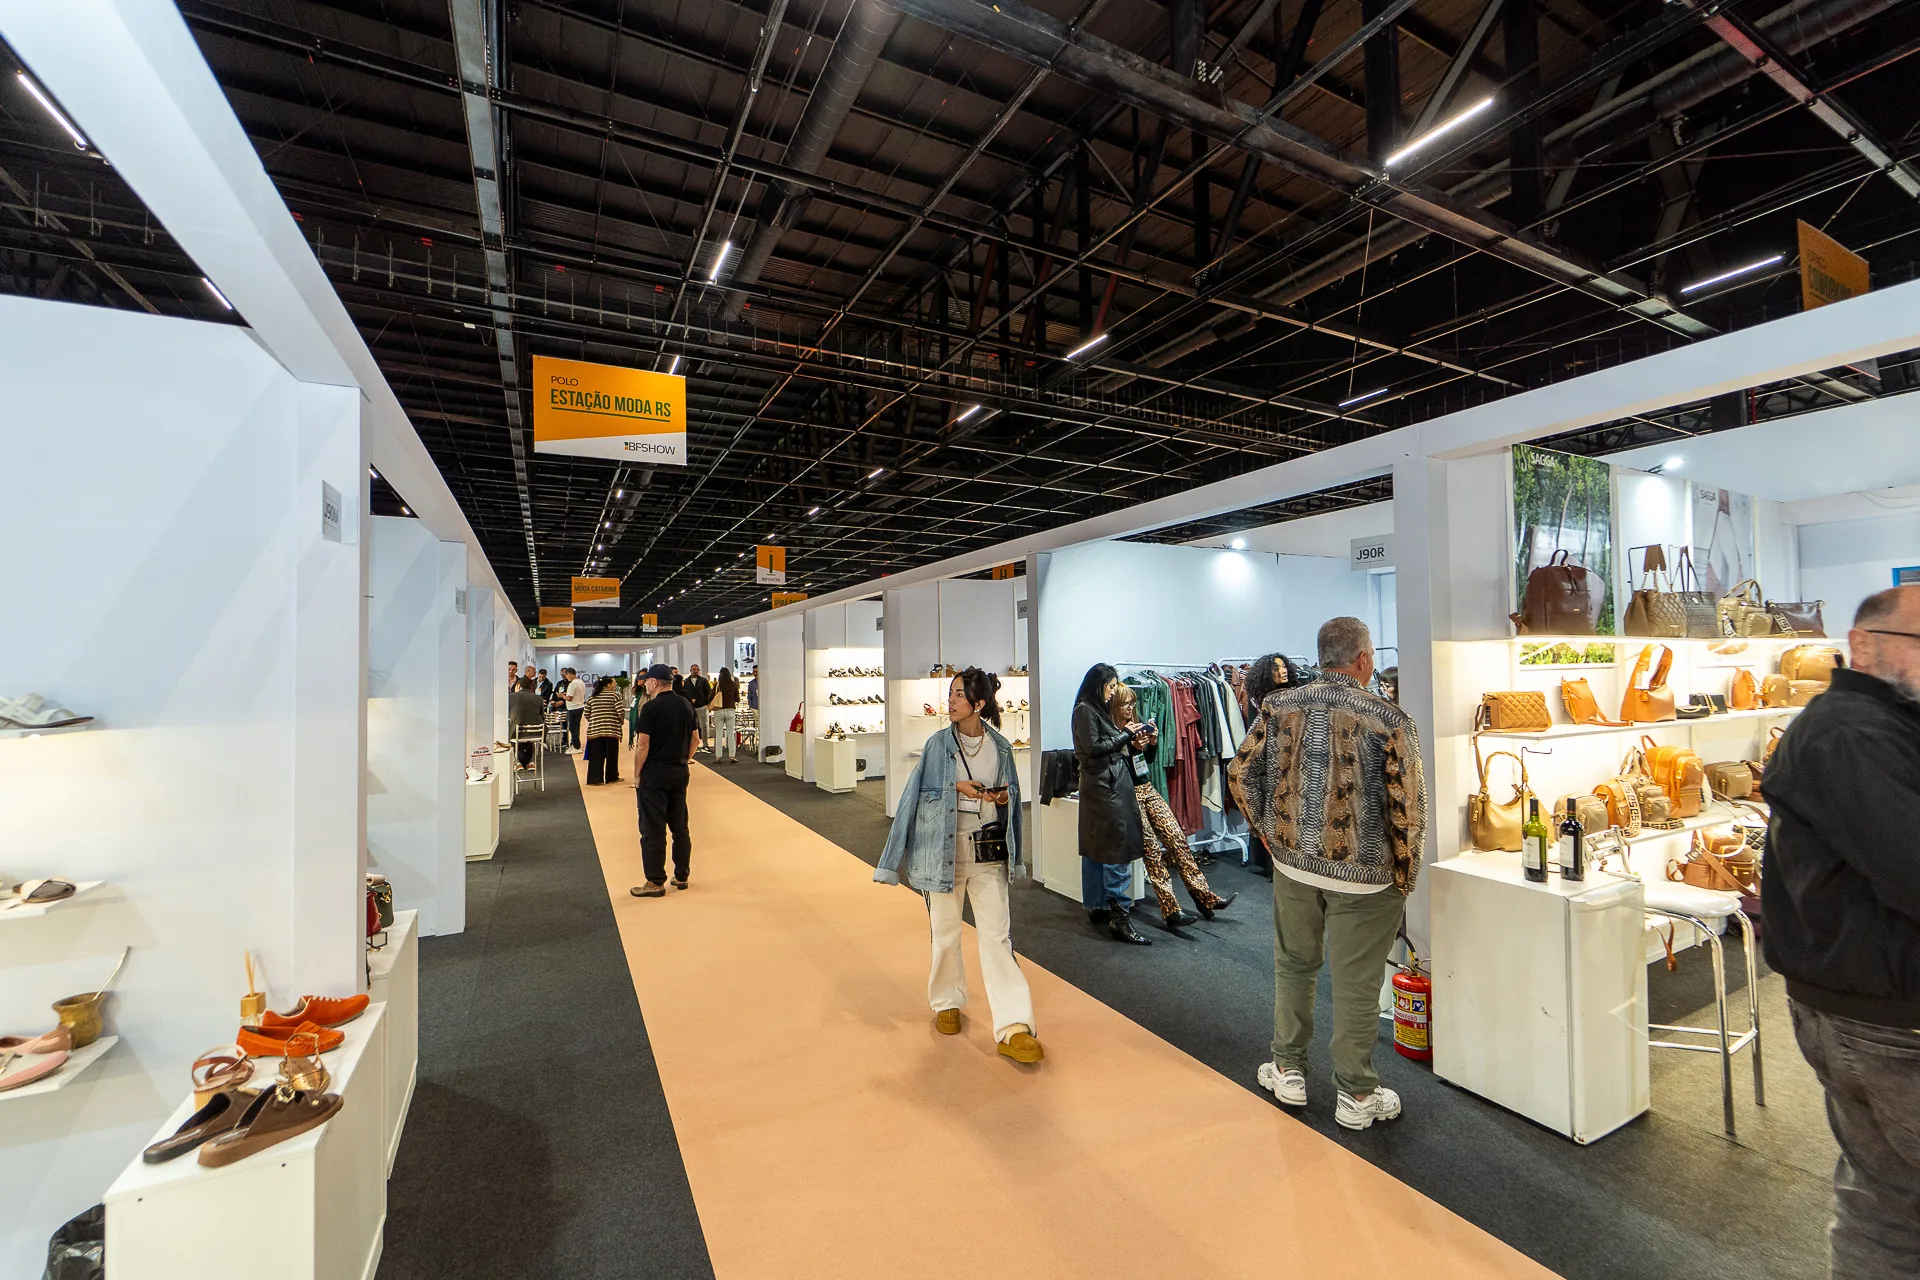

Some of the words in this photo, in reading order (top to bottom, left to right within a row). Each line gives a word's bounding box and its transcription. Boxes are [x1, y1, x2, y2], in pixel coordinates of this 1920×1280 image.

[551, 376, 579, 387] POLO
[551, 388, 611, 411] ESTAÇÃO
[615, 396, 652, 415] MODA
[656, 402, 671, 418] RS
[628, 442, 676, 456] BFSHOW
[1530, 452, 1556, 468] SAGGA
[1356, 547, 1385, 561] J90R
